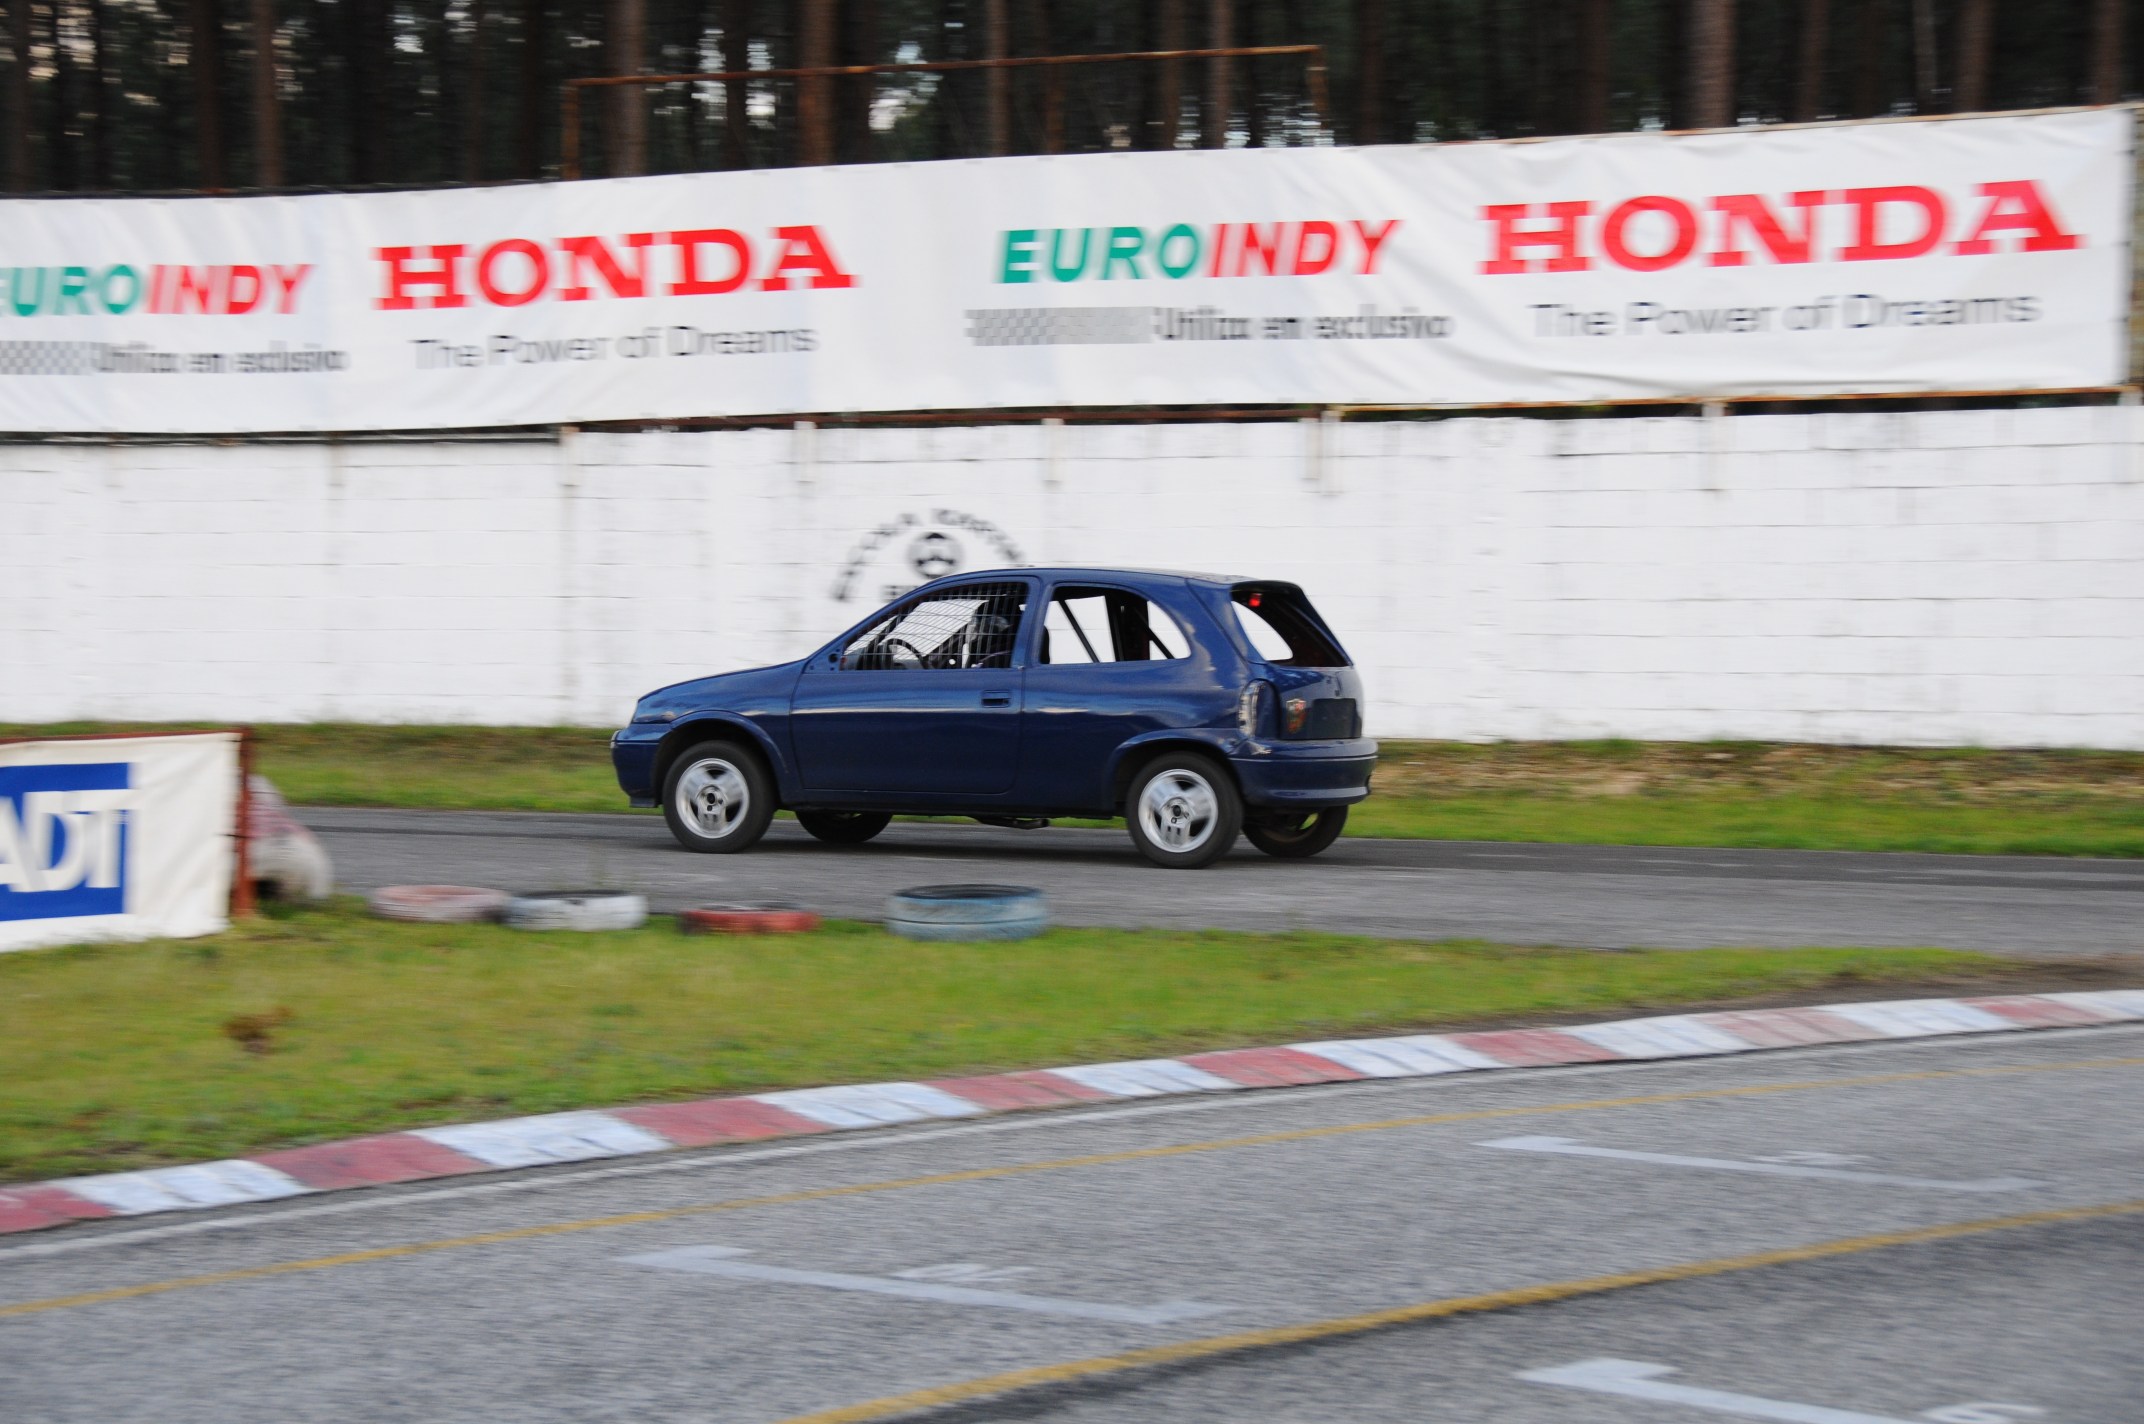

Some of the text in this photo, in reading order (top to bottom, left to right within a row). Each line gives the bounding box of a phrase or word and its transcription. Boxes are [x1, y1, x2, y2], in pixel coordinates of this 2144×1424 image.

[996, 219, 1404, 284] EUROINDY
[1478, 179, 2086, 275] HONDA
[0, 264, 314, 317] UROINDY
[372, 225, 860, 311] HONDA
[1526, 293, 2043, 337] The Power of Dreams
[408, 325, 819, 370] The Power of Dreams
